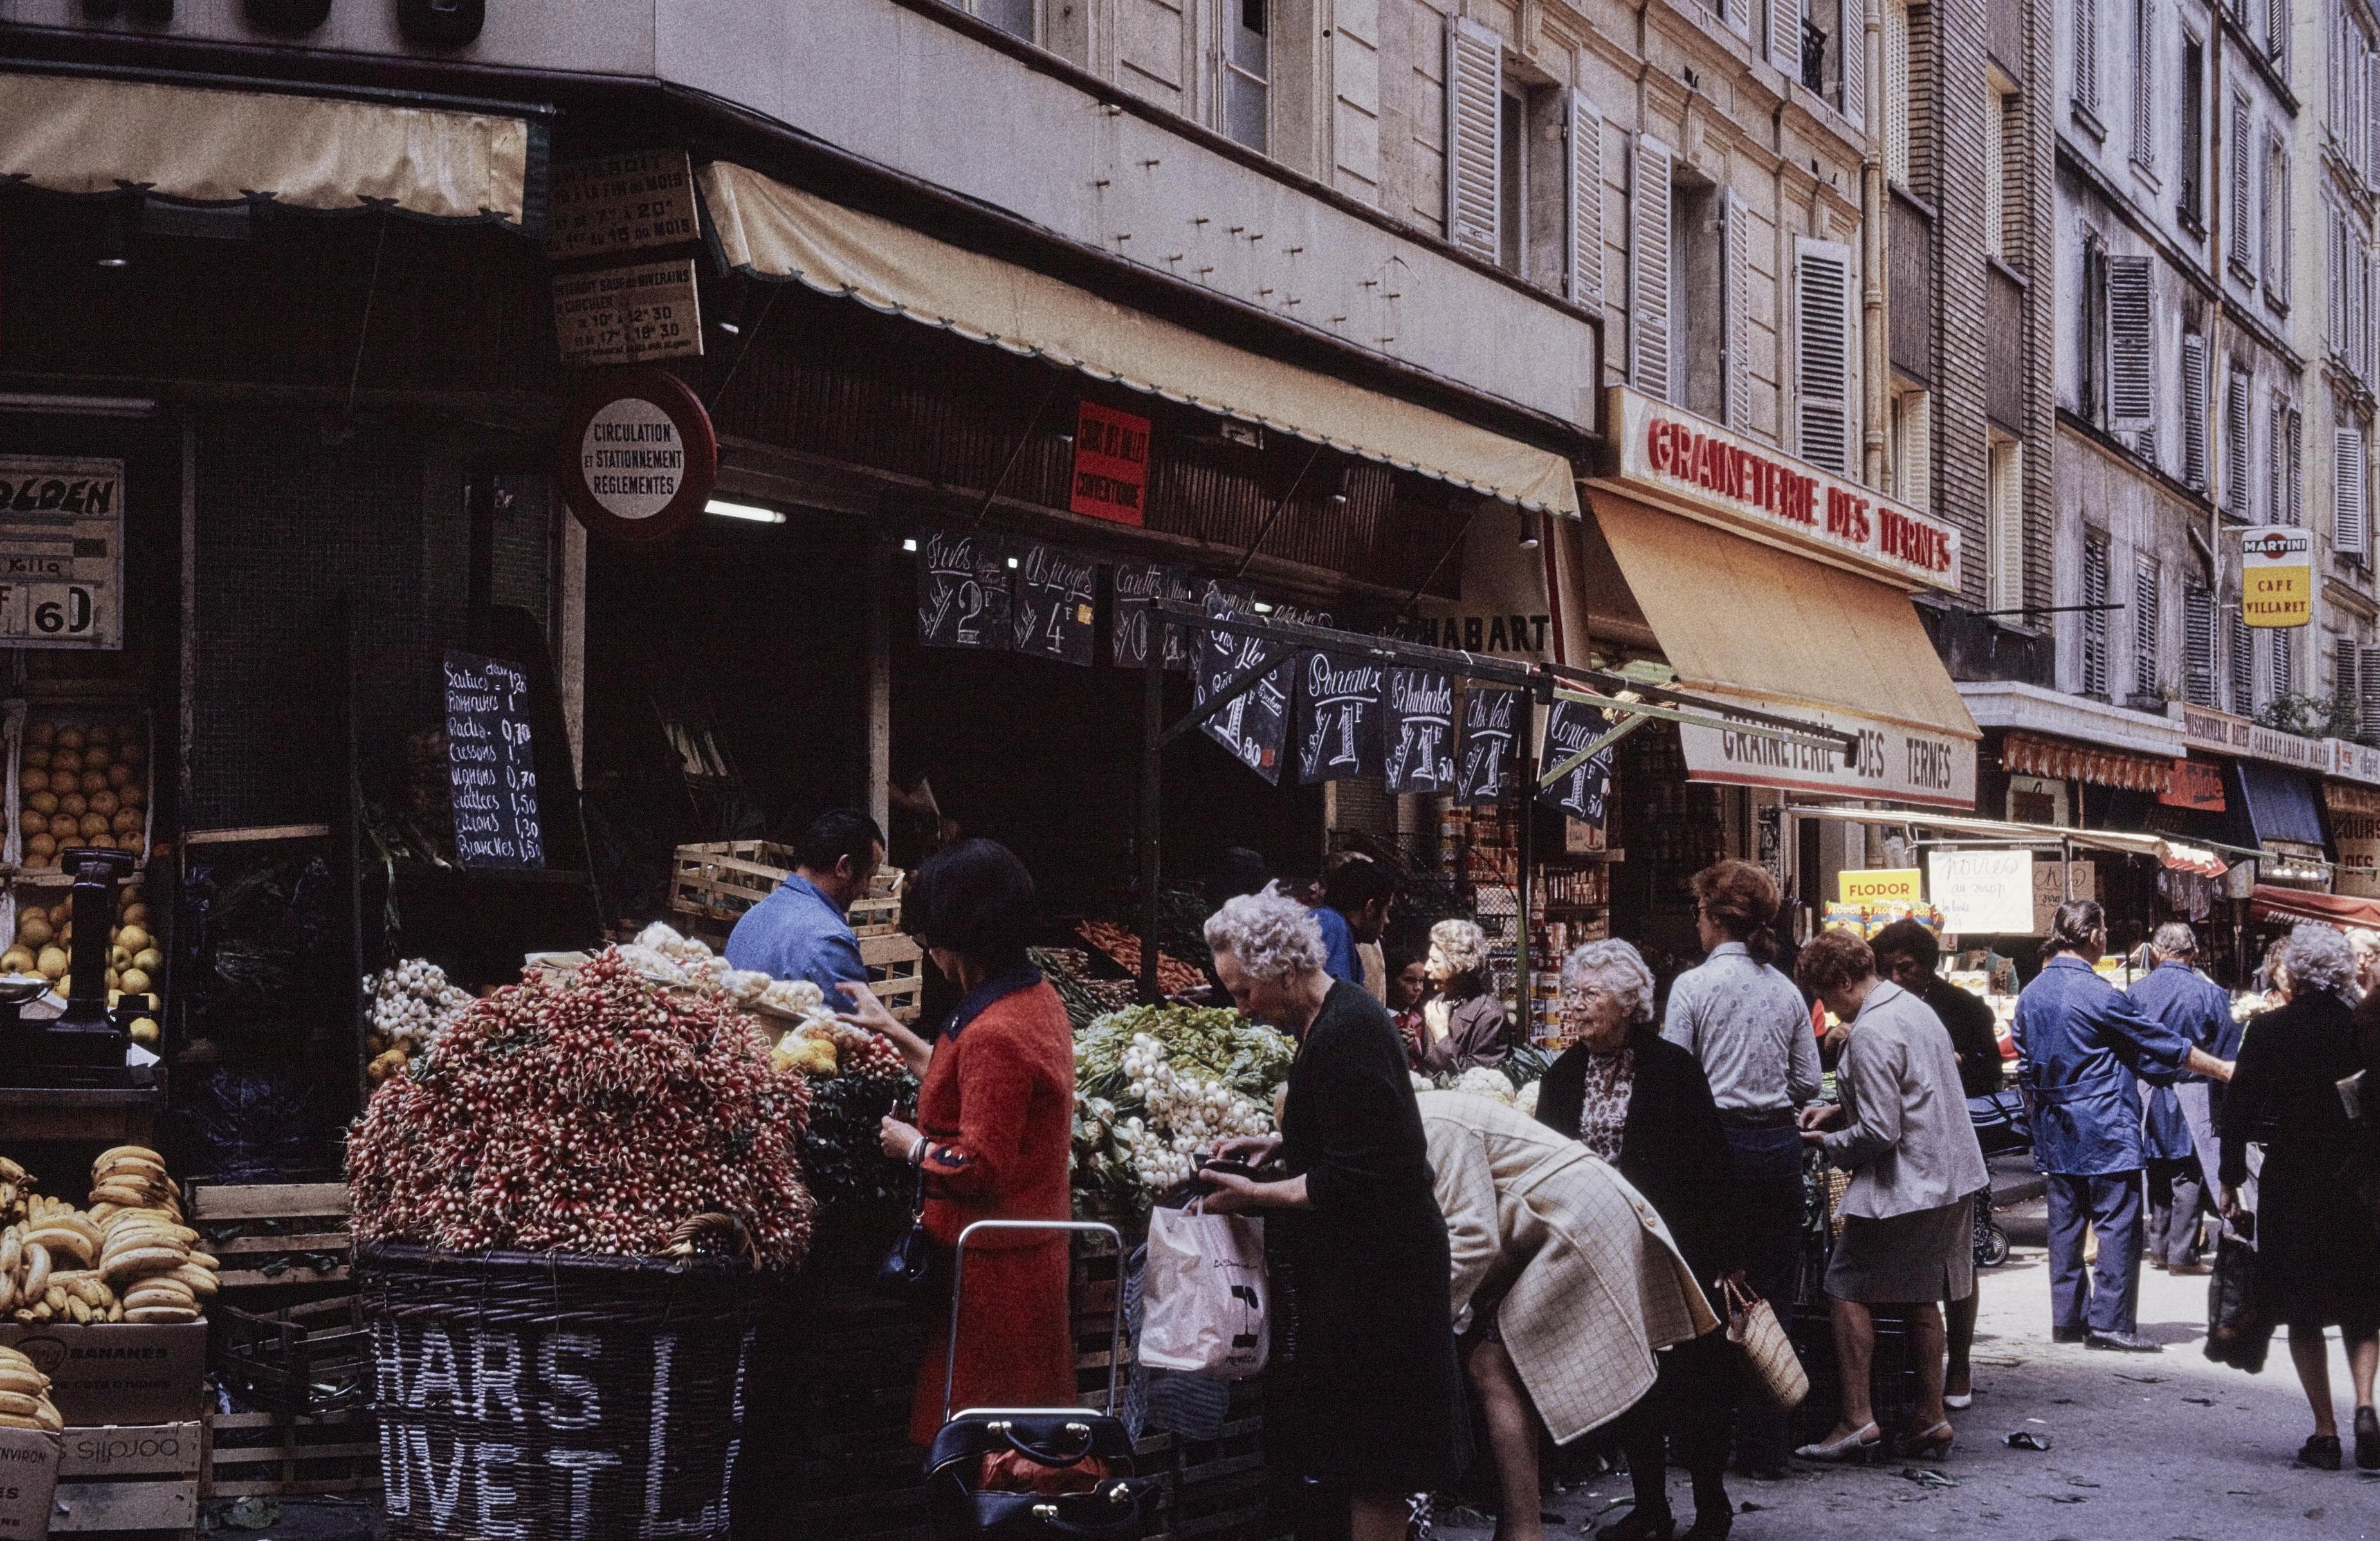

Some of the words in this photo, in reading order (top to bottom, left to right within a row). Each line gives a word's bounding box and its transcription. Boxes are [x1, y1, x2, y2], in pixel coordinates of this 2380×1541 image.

[646, 172, 682, 190] MOIS
[654, 218, 690, 236] MOIS
[594, 423, 670, 442] CIRCULATION
[585, 455, 594, 468] ET
[596, 450, 682, 469] STATIONNEMENT
[1648, 418, 1819, 527] GRAINETERIE
[1827, 486, 1870, 544] DES
[1878, 507, 1952, 572] TERNES
[2244, 539, 2306, 552] MARTINI
[957, 580, 983, 645] 2
[2246, 601, 2306, 614] VILLARET
[1046, 602, 1065, 653] 4
[1391, 671, 1453, 715] Rhubarbes
[1858, 728, 1885, 779] DES
[1906, 737, 1952, 789] TERNES
[1849, 883, 1910, 896] FLODOR
[69, 1347, 168, 1359] BANANES
